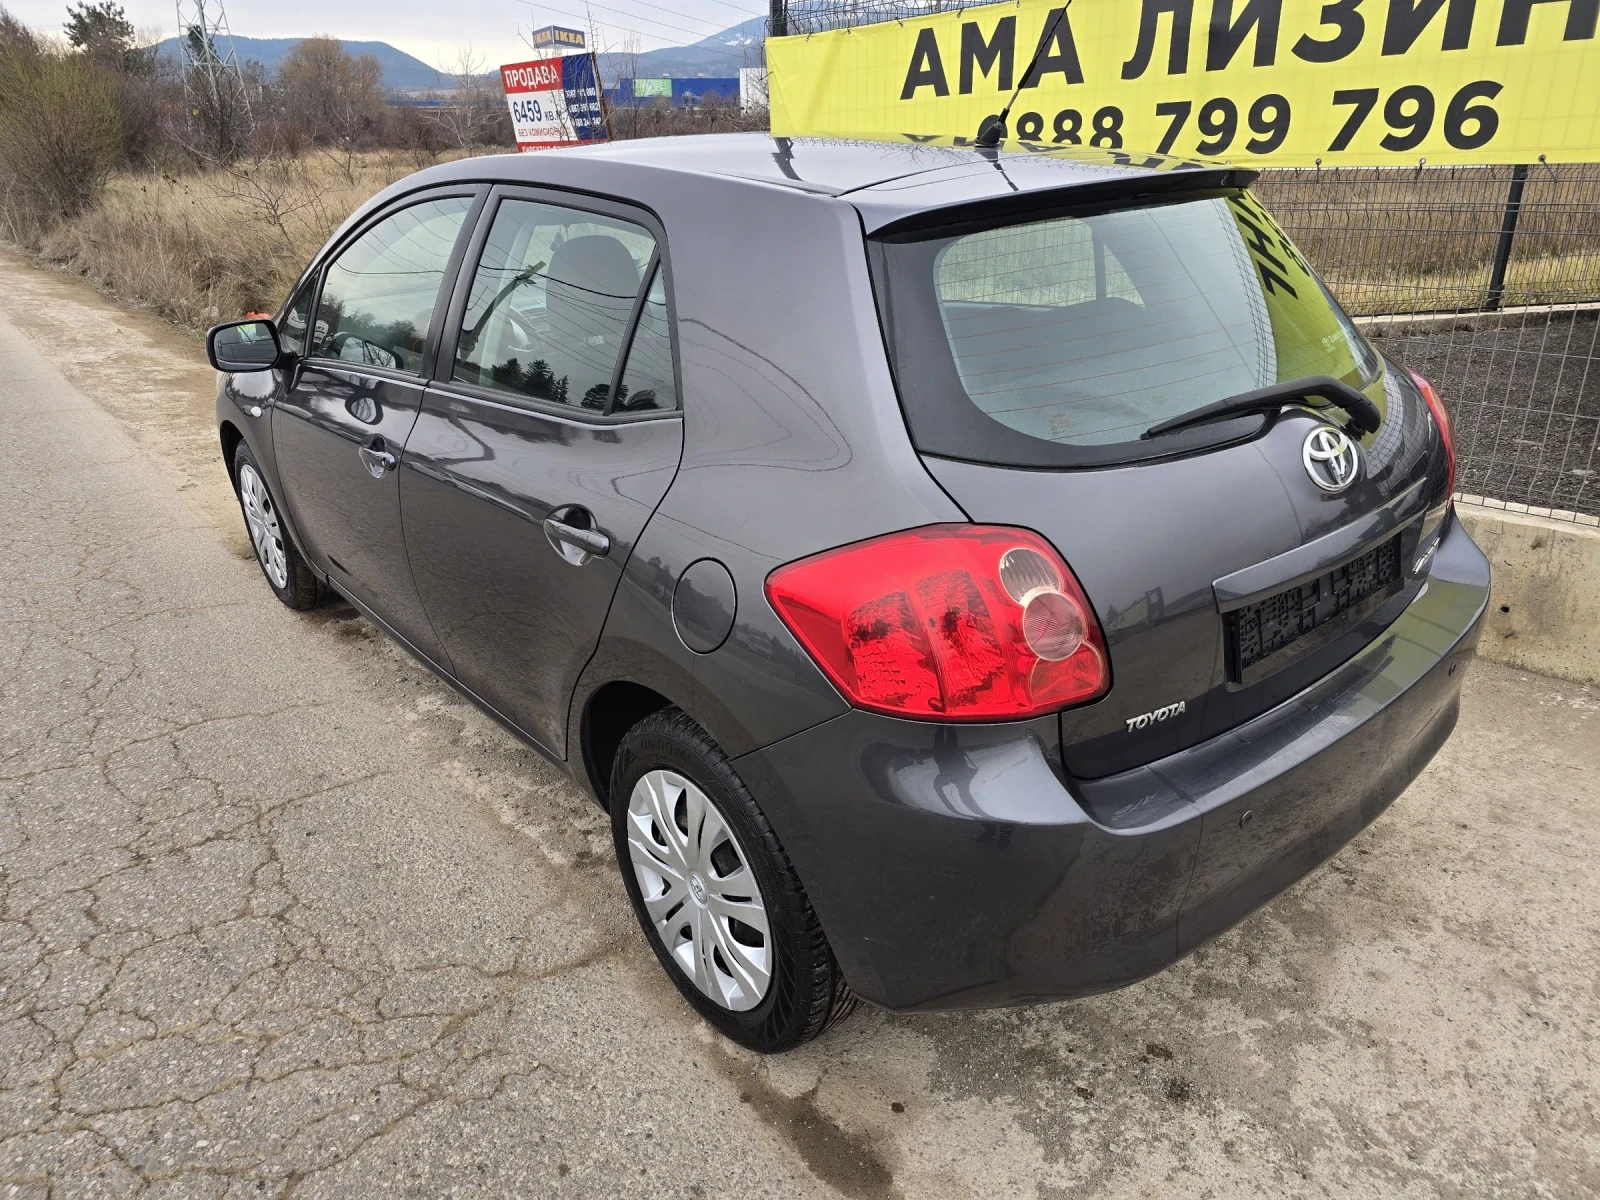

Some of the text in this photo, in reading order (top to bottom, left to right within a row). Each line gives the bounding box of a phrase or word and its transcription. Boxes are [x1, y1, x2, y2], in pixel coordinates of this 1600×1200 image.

[554, 30, 584, 45] IKEA
[900, 8, 1084, 100] АМА
[505, 65, 558, 89] ПРОДАВА
[513, 99, 542, 123] 6459
[1155, 94, 1292, 156] 799
[1327, 80, 1504, 152] 796
[1126, 700, 1186, 733] TOYOTA
